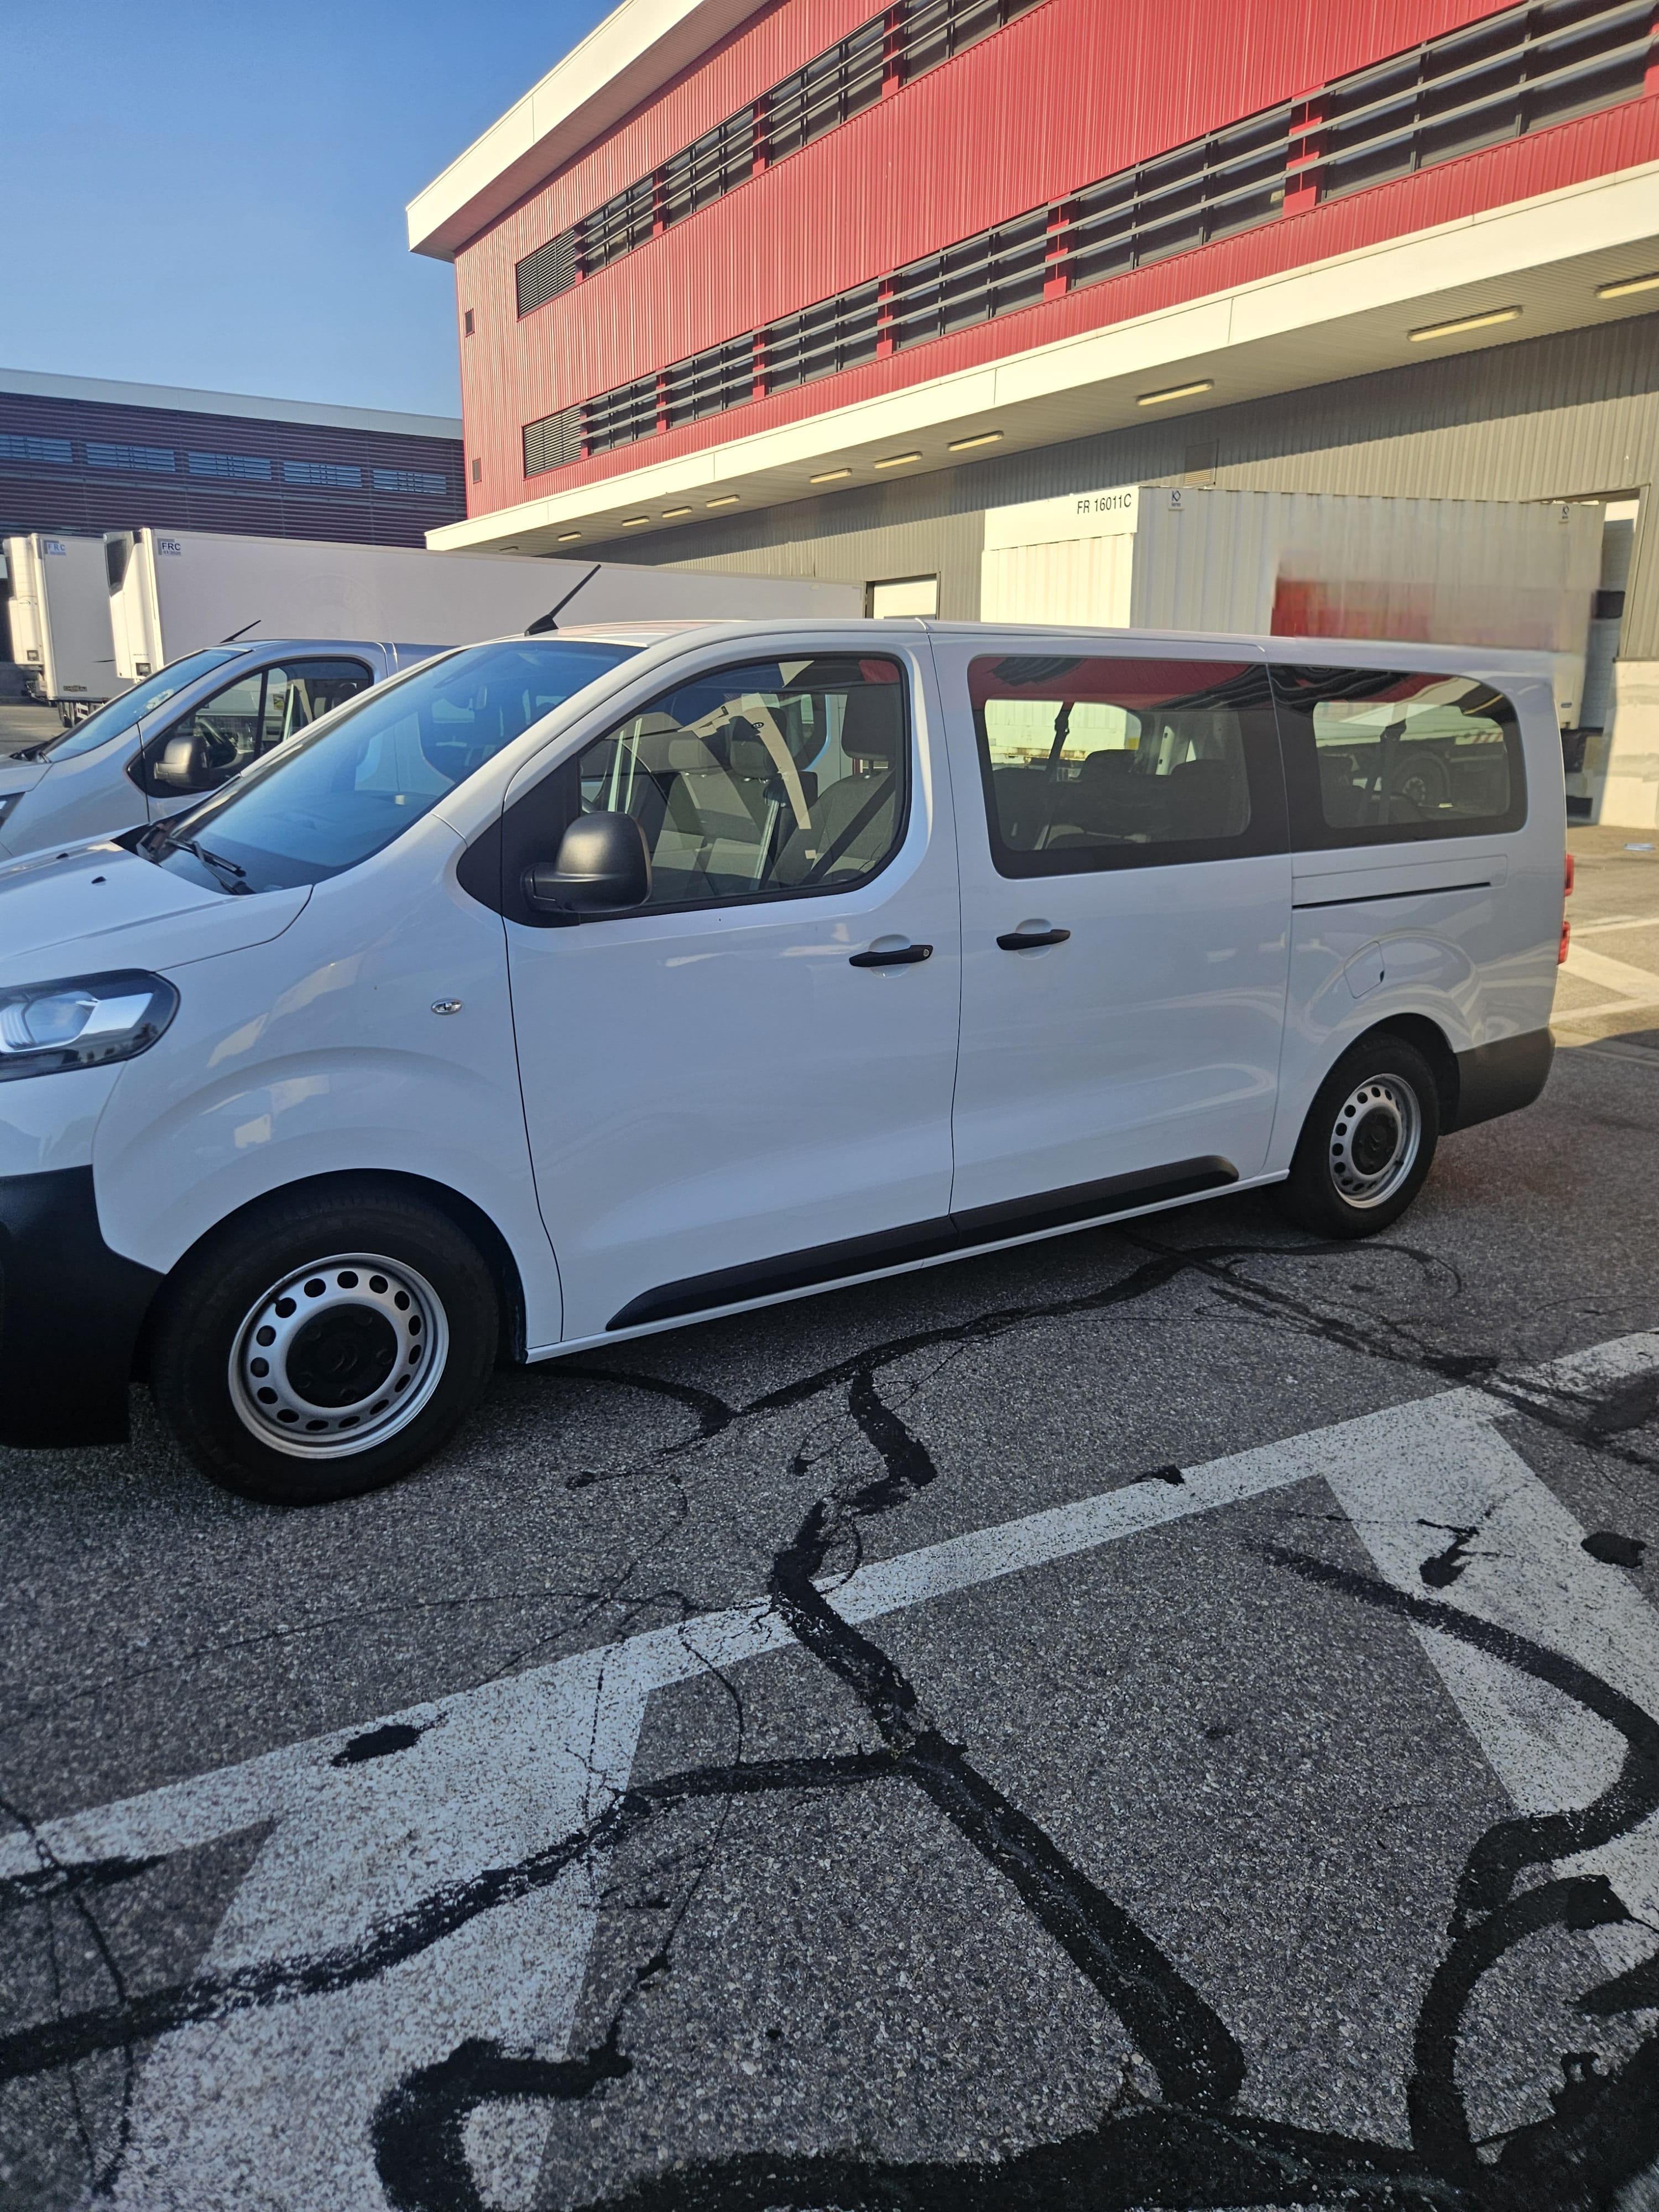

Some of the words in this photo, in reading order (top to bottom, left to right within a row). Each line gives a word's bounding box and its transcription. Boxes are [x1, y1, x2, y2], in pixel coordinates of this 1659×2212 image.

[1077, 500, 1090, 514] FR
[1094, 493, 1131, 512] 16011C
[162, 542, 181, 551] FRC
